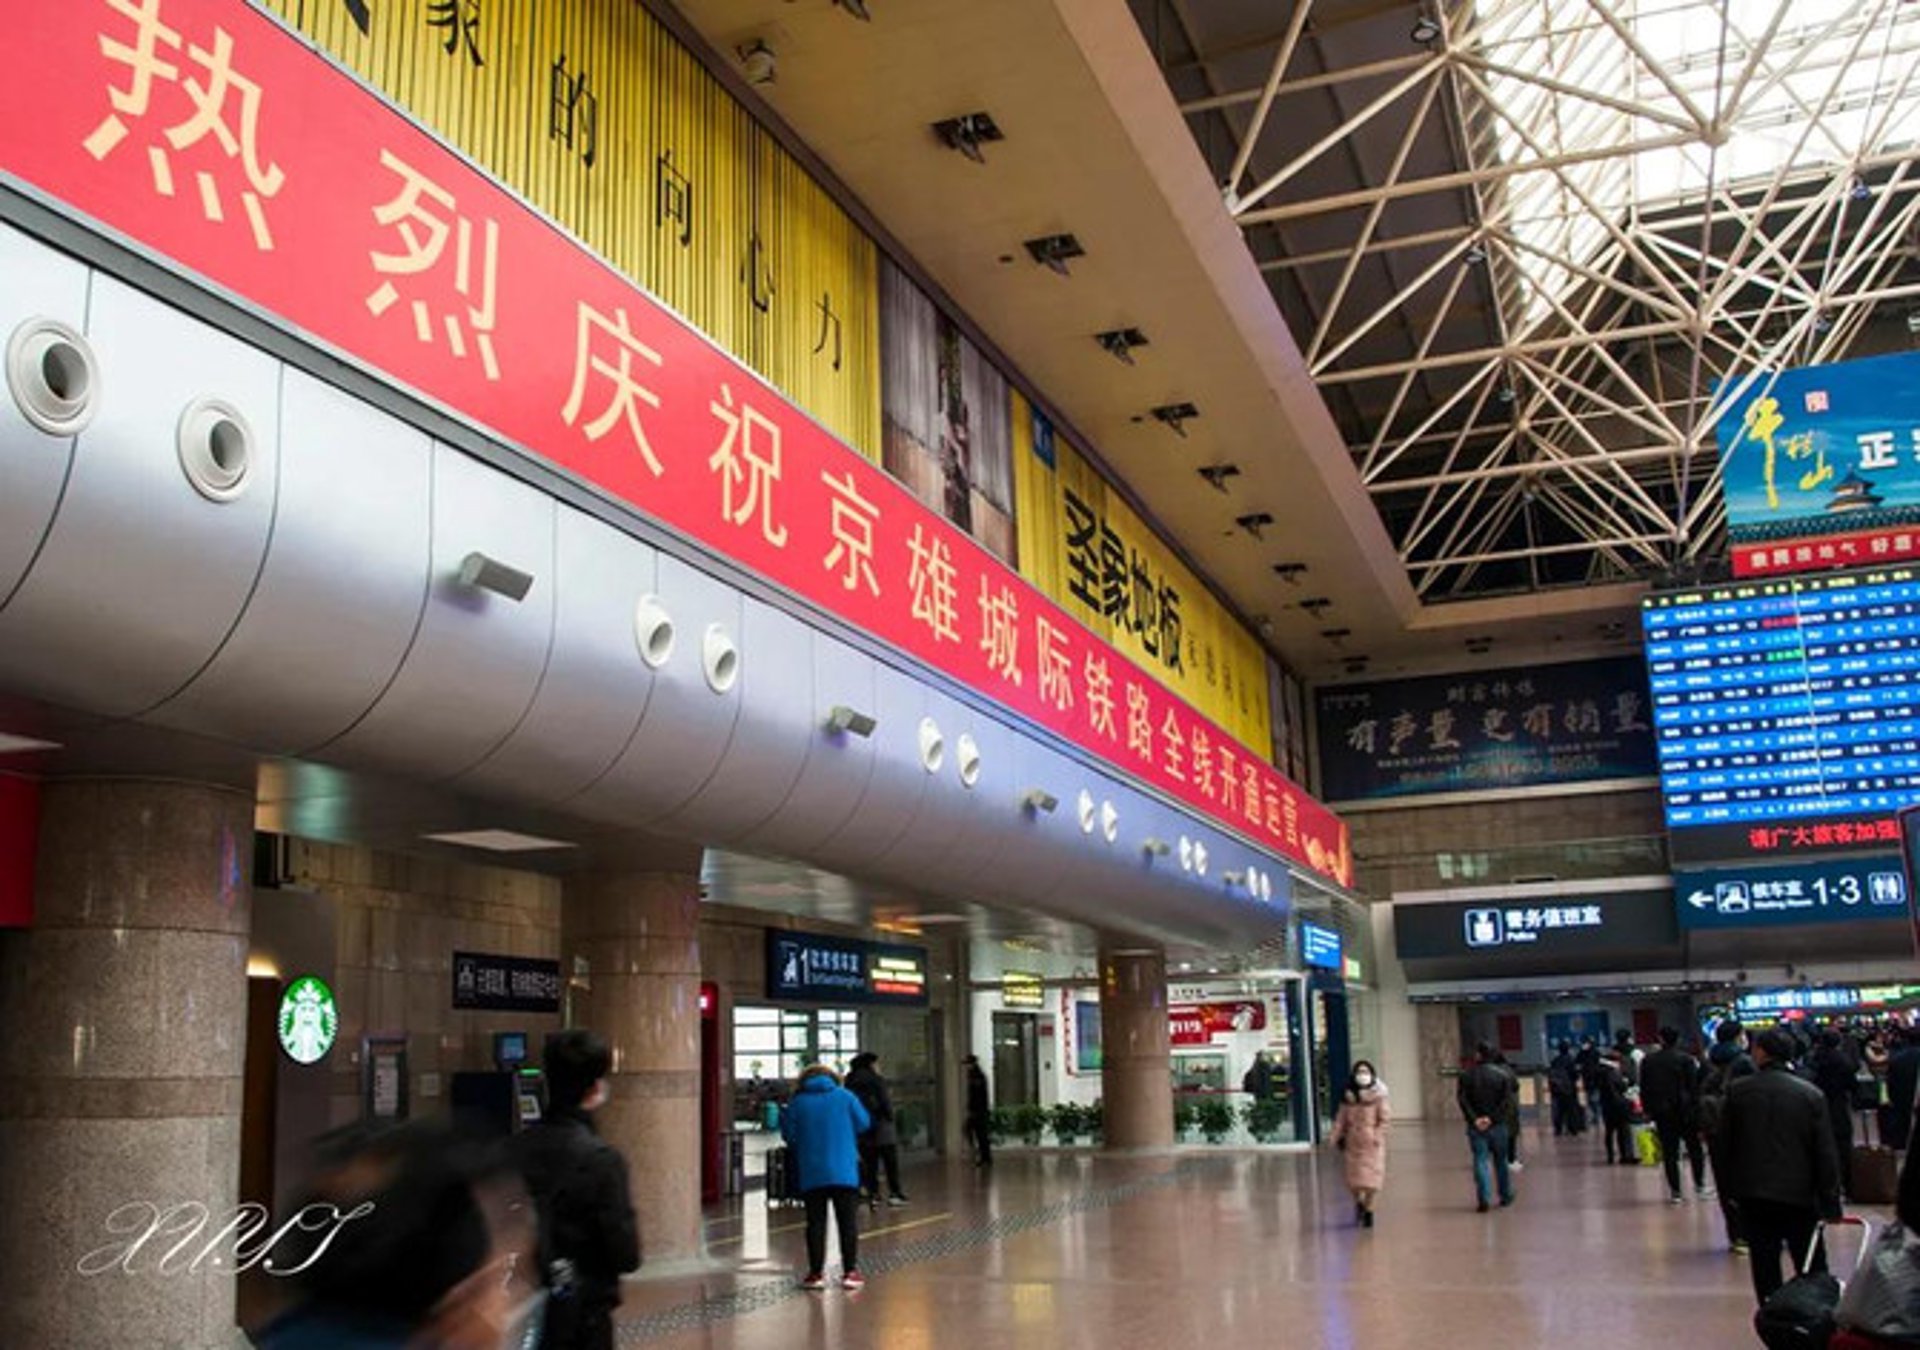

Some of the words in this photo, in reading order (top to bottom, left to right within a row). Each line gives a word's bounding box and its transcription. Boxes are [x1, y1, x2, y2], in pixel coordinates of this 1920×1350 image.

[83, 0, 1298, 846] 热烈庆祝京雄城际铁路全线开通运营
